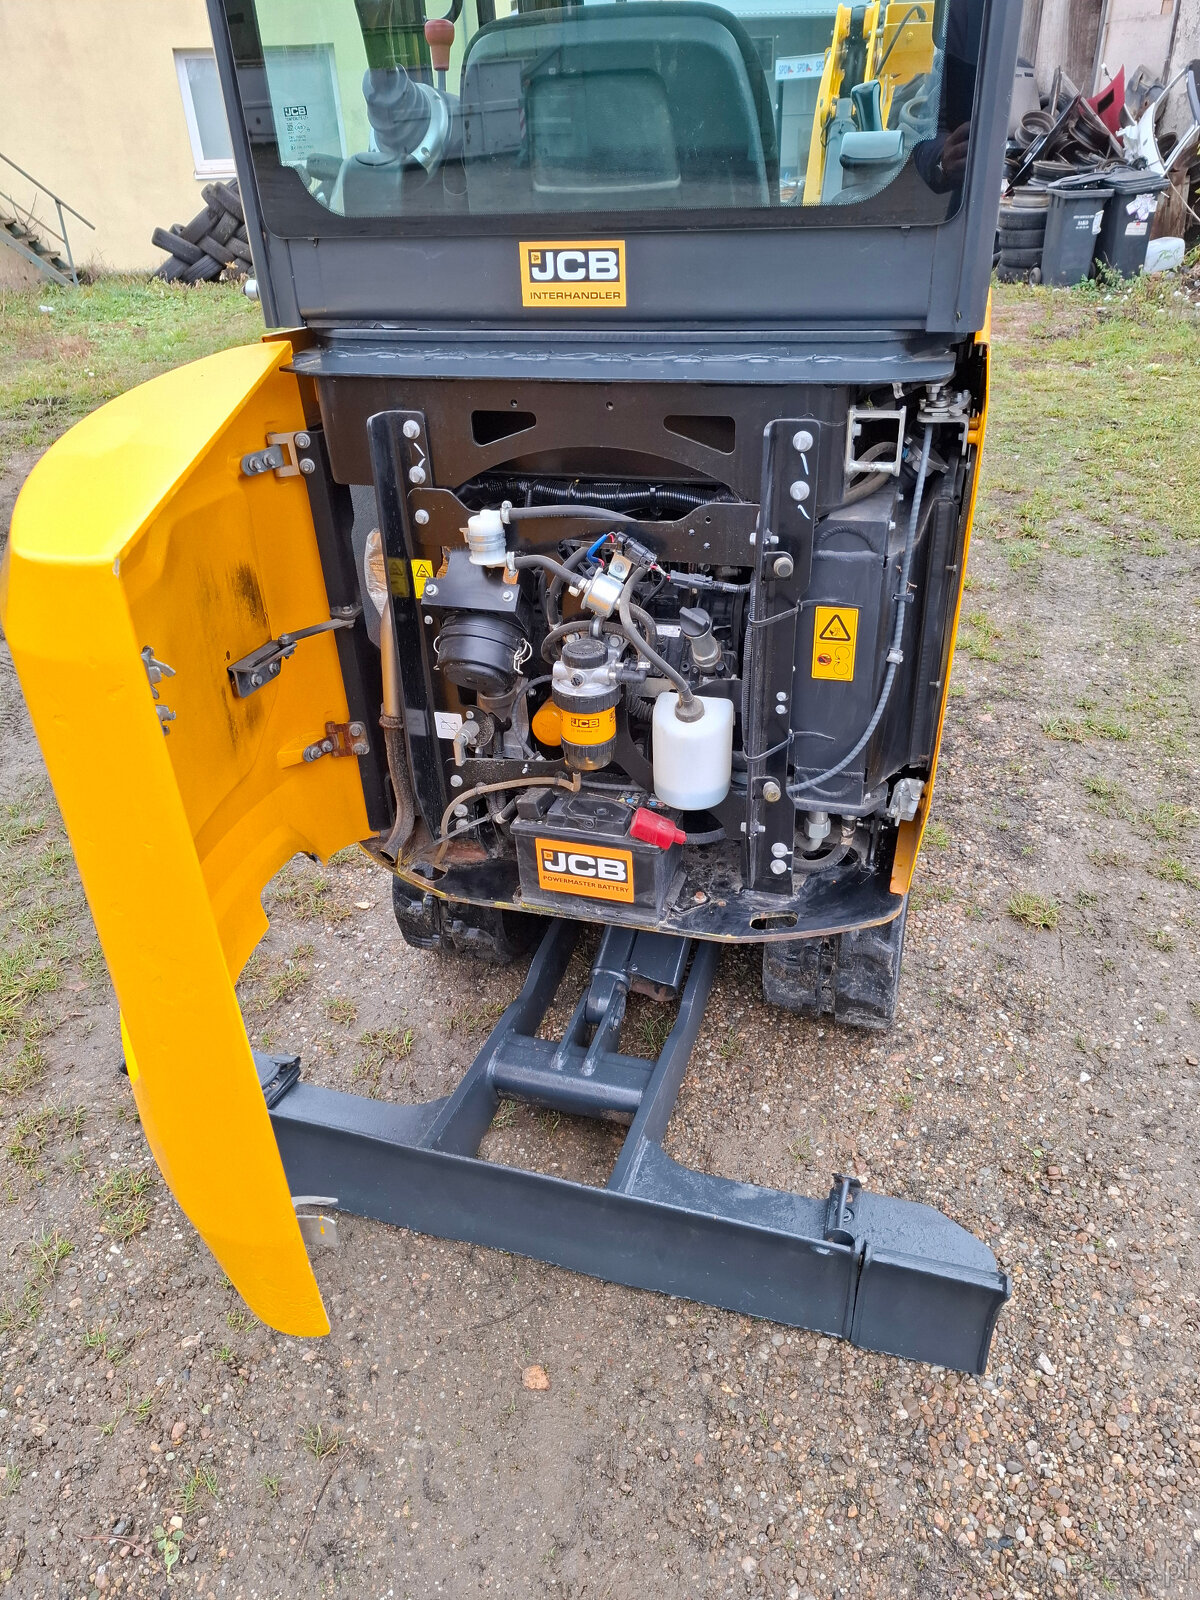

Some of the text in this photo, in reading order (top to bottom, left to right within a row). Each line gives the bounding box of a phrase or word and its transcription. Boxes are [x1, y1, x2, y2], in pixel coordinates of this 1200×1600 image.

[285, 107, 306, 117] JCB
[531, 251, 619, 281] JCB
[530, 291, 621, 300] INTERHANDLER
[571, 718, 599, 729] JCB
[543, 852, 627, 882] JCB
[543, 875, 630, 894] POWERMASTER BATTERY
